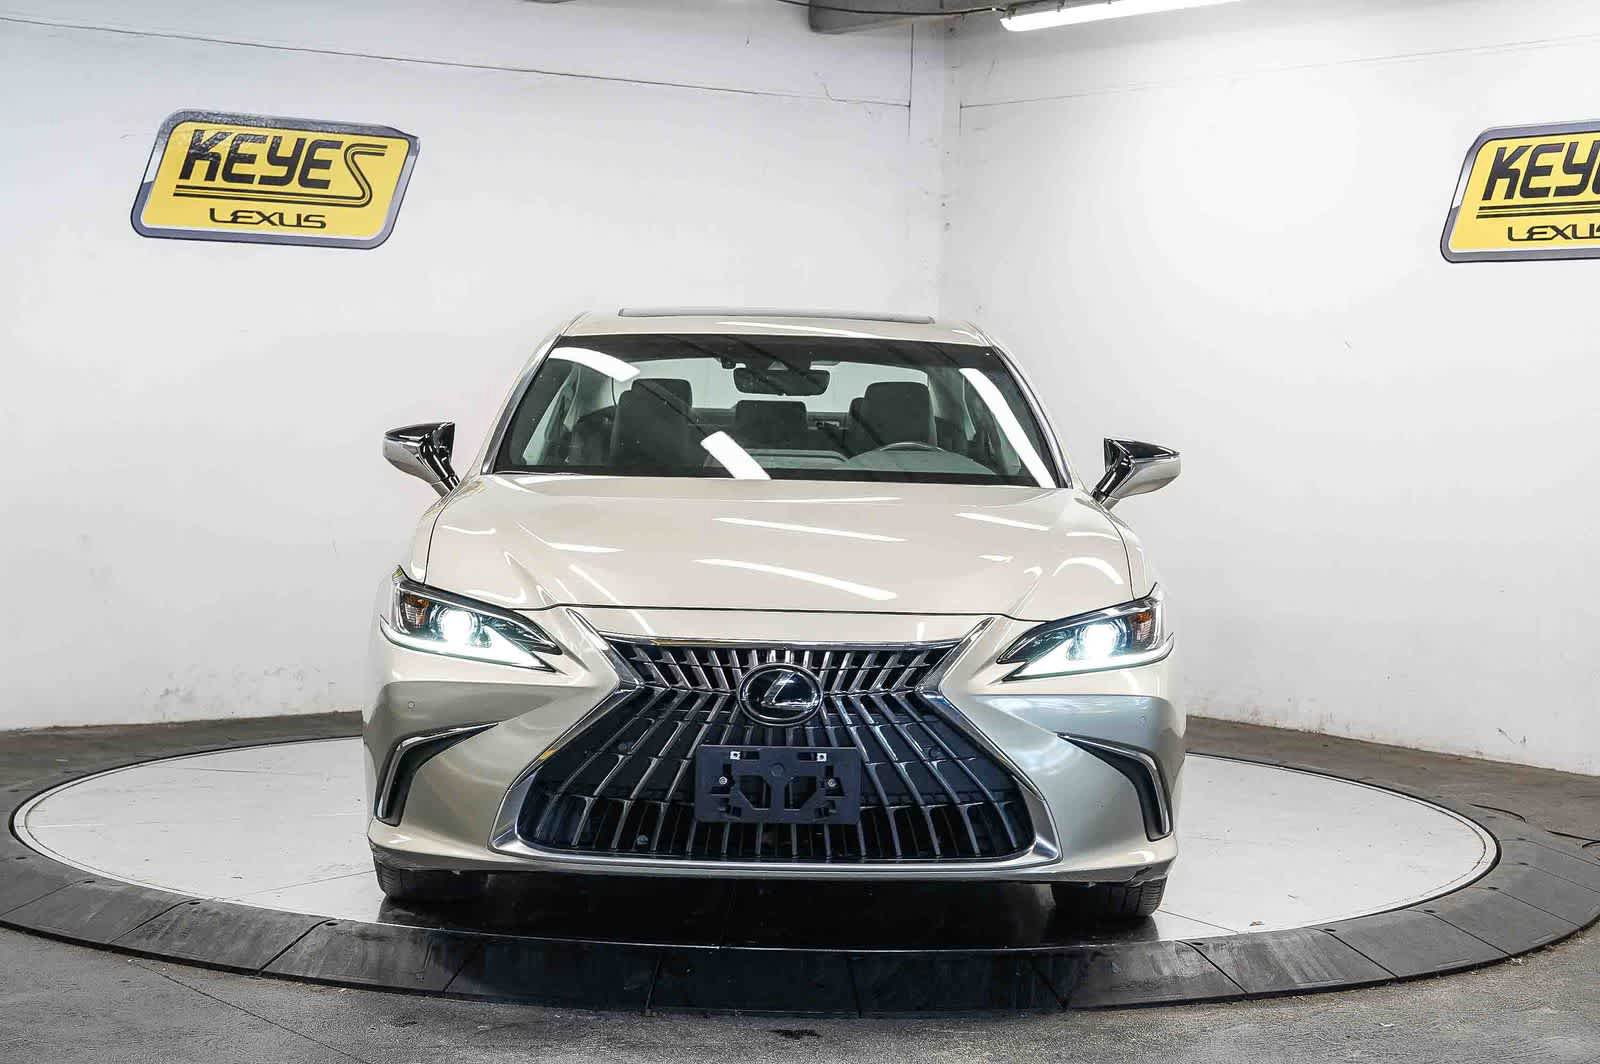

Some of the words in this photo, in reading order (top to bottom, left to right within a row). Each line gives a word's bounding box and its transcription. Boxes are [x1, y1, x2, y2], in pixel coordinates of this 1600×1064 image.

[174, 129, 387, 208] KEYES
[1482, 140, 1600, 201] KEY
[209, 207, 326, 229] LEXUS
[1507, 223, 1600, 241] LEXU
